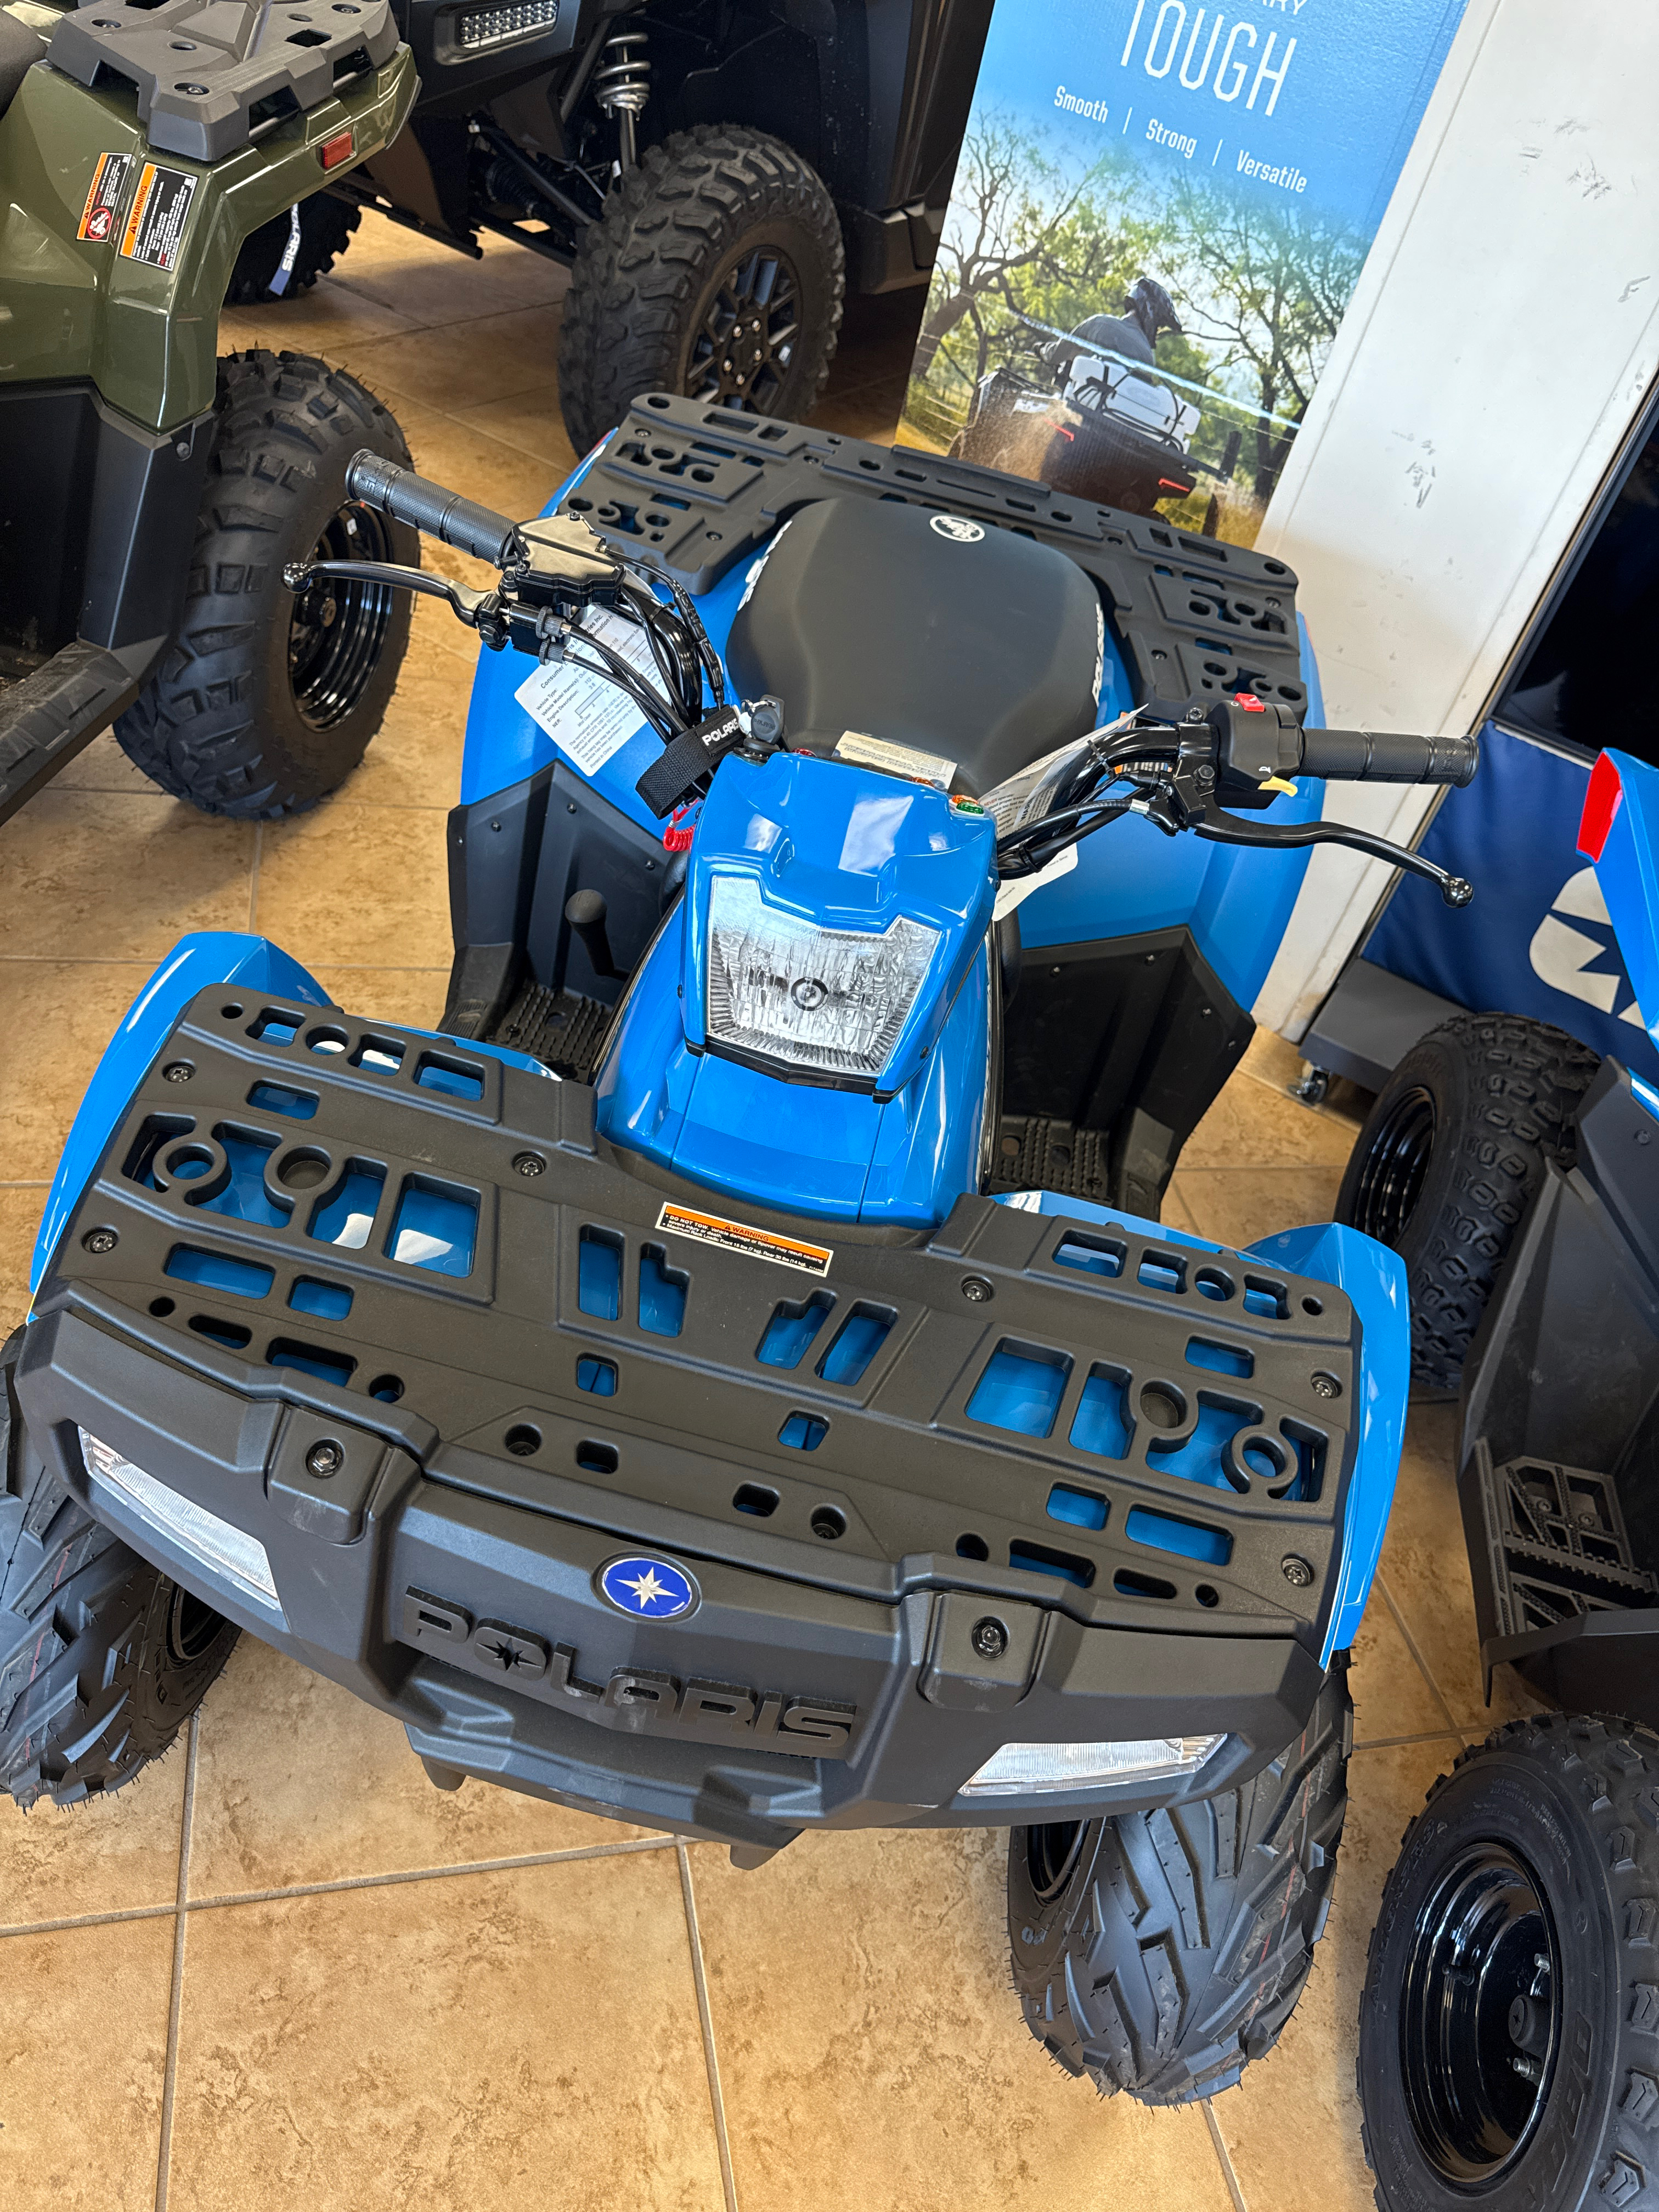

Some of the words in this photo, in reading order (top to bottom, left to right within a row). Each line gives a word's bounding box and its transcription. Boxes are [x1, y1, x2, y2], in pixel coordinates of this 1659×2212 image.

[1054, 85, 1109, 125] Smooth
[1146, 118, 1197, 159] Strong
[1237, 149, 1307, 194] Versatile
[85, 173, 100, 211] WARNING
[130, 184, 148, 224] WARNING
[540, 664, 565, 689] Consumer
[535, 697, 549, 711] Vehicle
[547, 687, 559, 699] Type:
[540, 702, 555, 716] Vehicle
[552, 692, 565, 704] Model
[563, 677, 580, 695] Name(s):
[546, 709, 560, 723] Engine
[557, 689, 580, 711] Description:
[552, 718, 562, 727] NER:
[702, 718, 739, 746] POLARIS
[666, 1223, 690, 1233] Maximum
[668, 1219, 685, 1227] severe
[685, 1224, 699, 1232] injury
[732, 1226, 769, 1242] WARNING
[694, 1222, 709, 1230] TOW.
[710, 1227, 729, 1235] Vehicle
[729, 1232, 751, 1243] damage
[803, 1254, 823, 1263] causing
[404, 1585, 857, 1747] POLARIS
